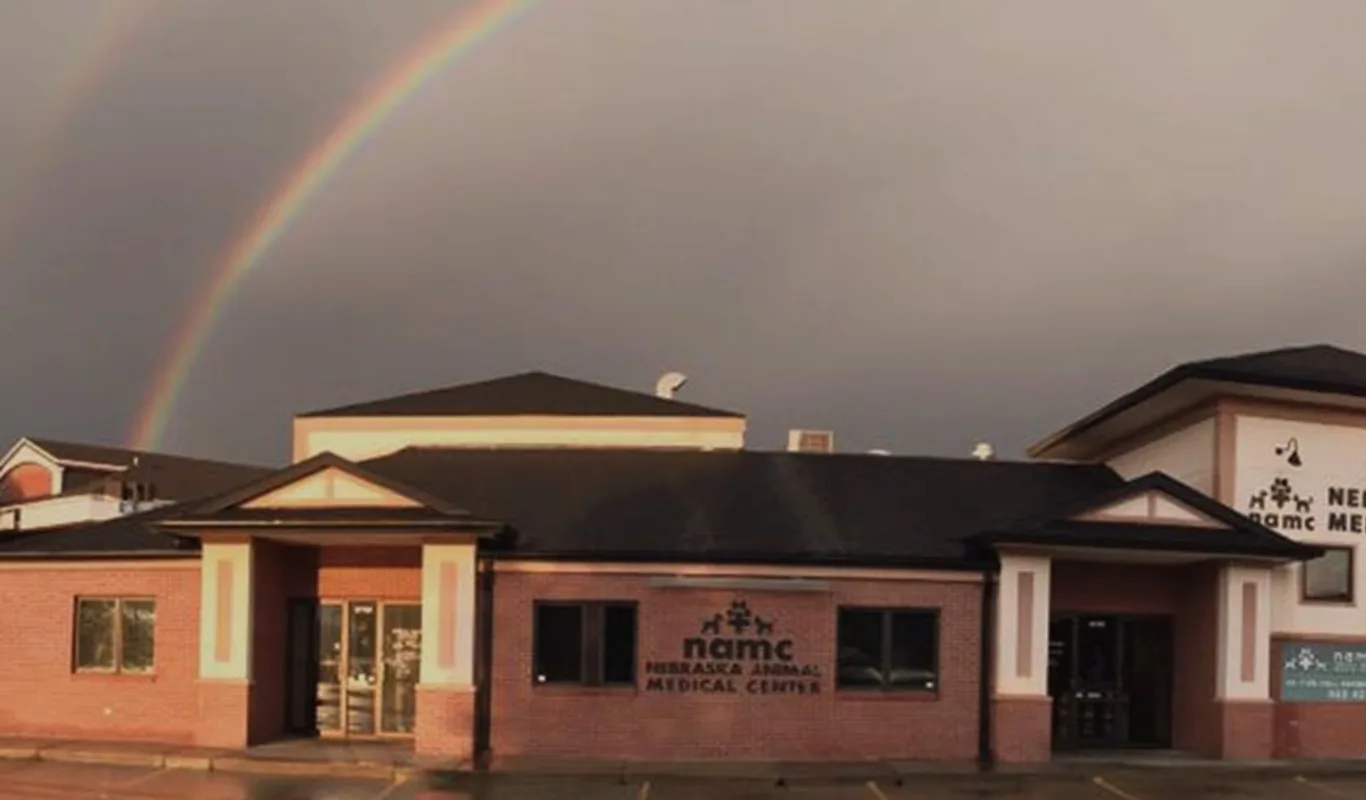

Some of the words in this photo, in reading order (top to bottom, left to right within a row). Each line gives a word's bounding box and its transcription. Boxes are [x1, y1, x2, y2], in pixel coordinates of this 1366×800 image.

[1250, 512, 1316, 532] namc
[683, 637, 793, 661] namc
[645, 661, 742, 675] NEBRASKA
[751, 662, 822, 678] ANIMAL
[646, 678, 737, 693] MEDICAL
[746, 679, 821, 694] CENTER
